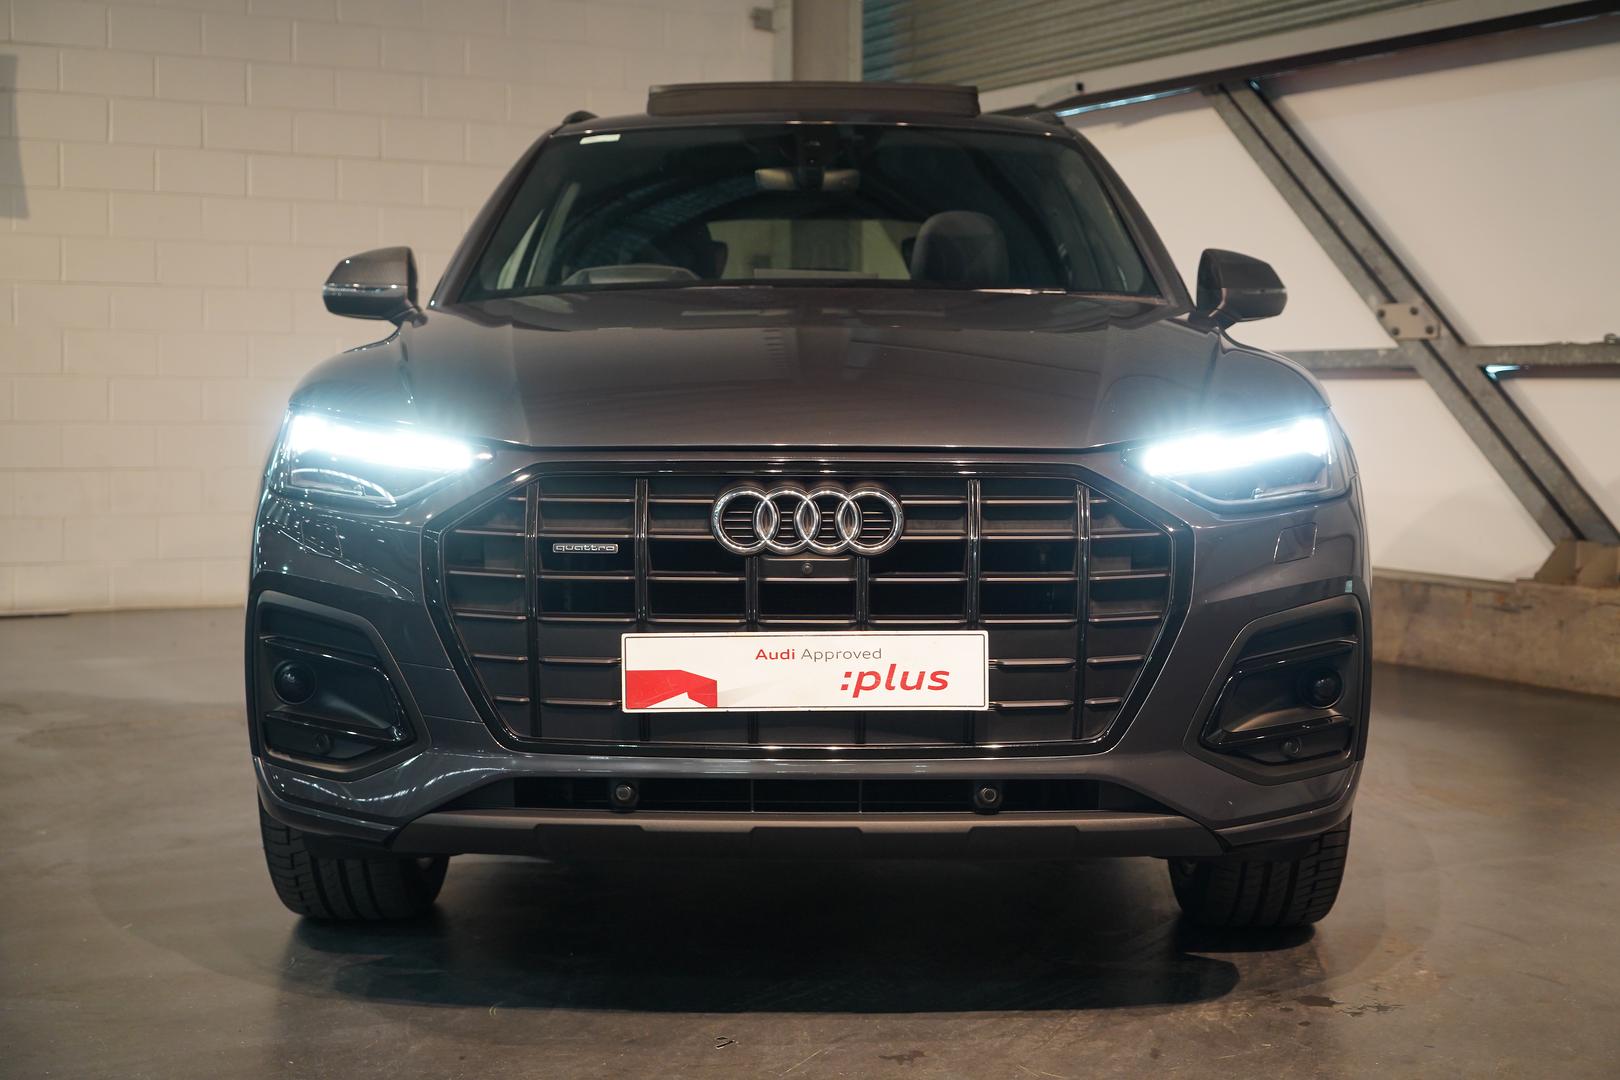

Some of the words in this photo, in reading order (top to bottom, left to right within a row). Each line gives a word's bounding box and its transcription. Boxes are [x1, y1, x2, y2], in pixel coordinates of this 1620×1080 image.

[555, 544, 615, 552] quattro
[755, 648, 796, 661] Audi
[801, 647, 883, 663] Approved
